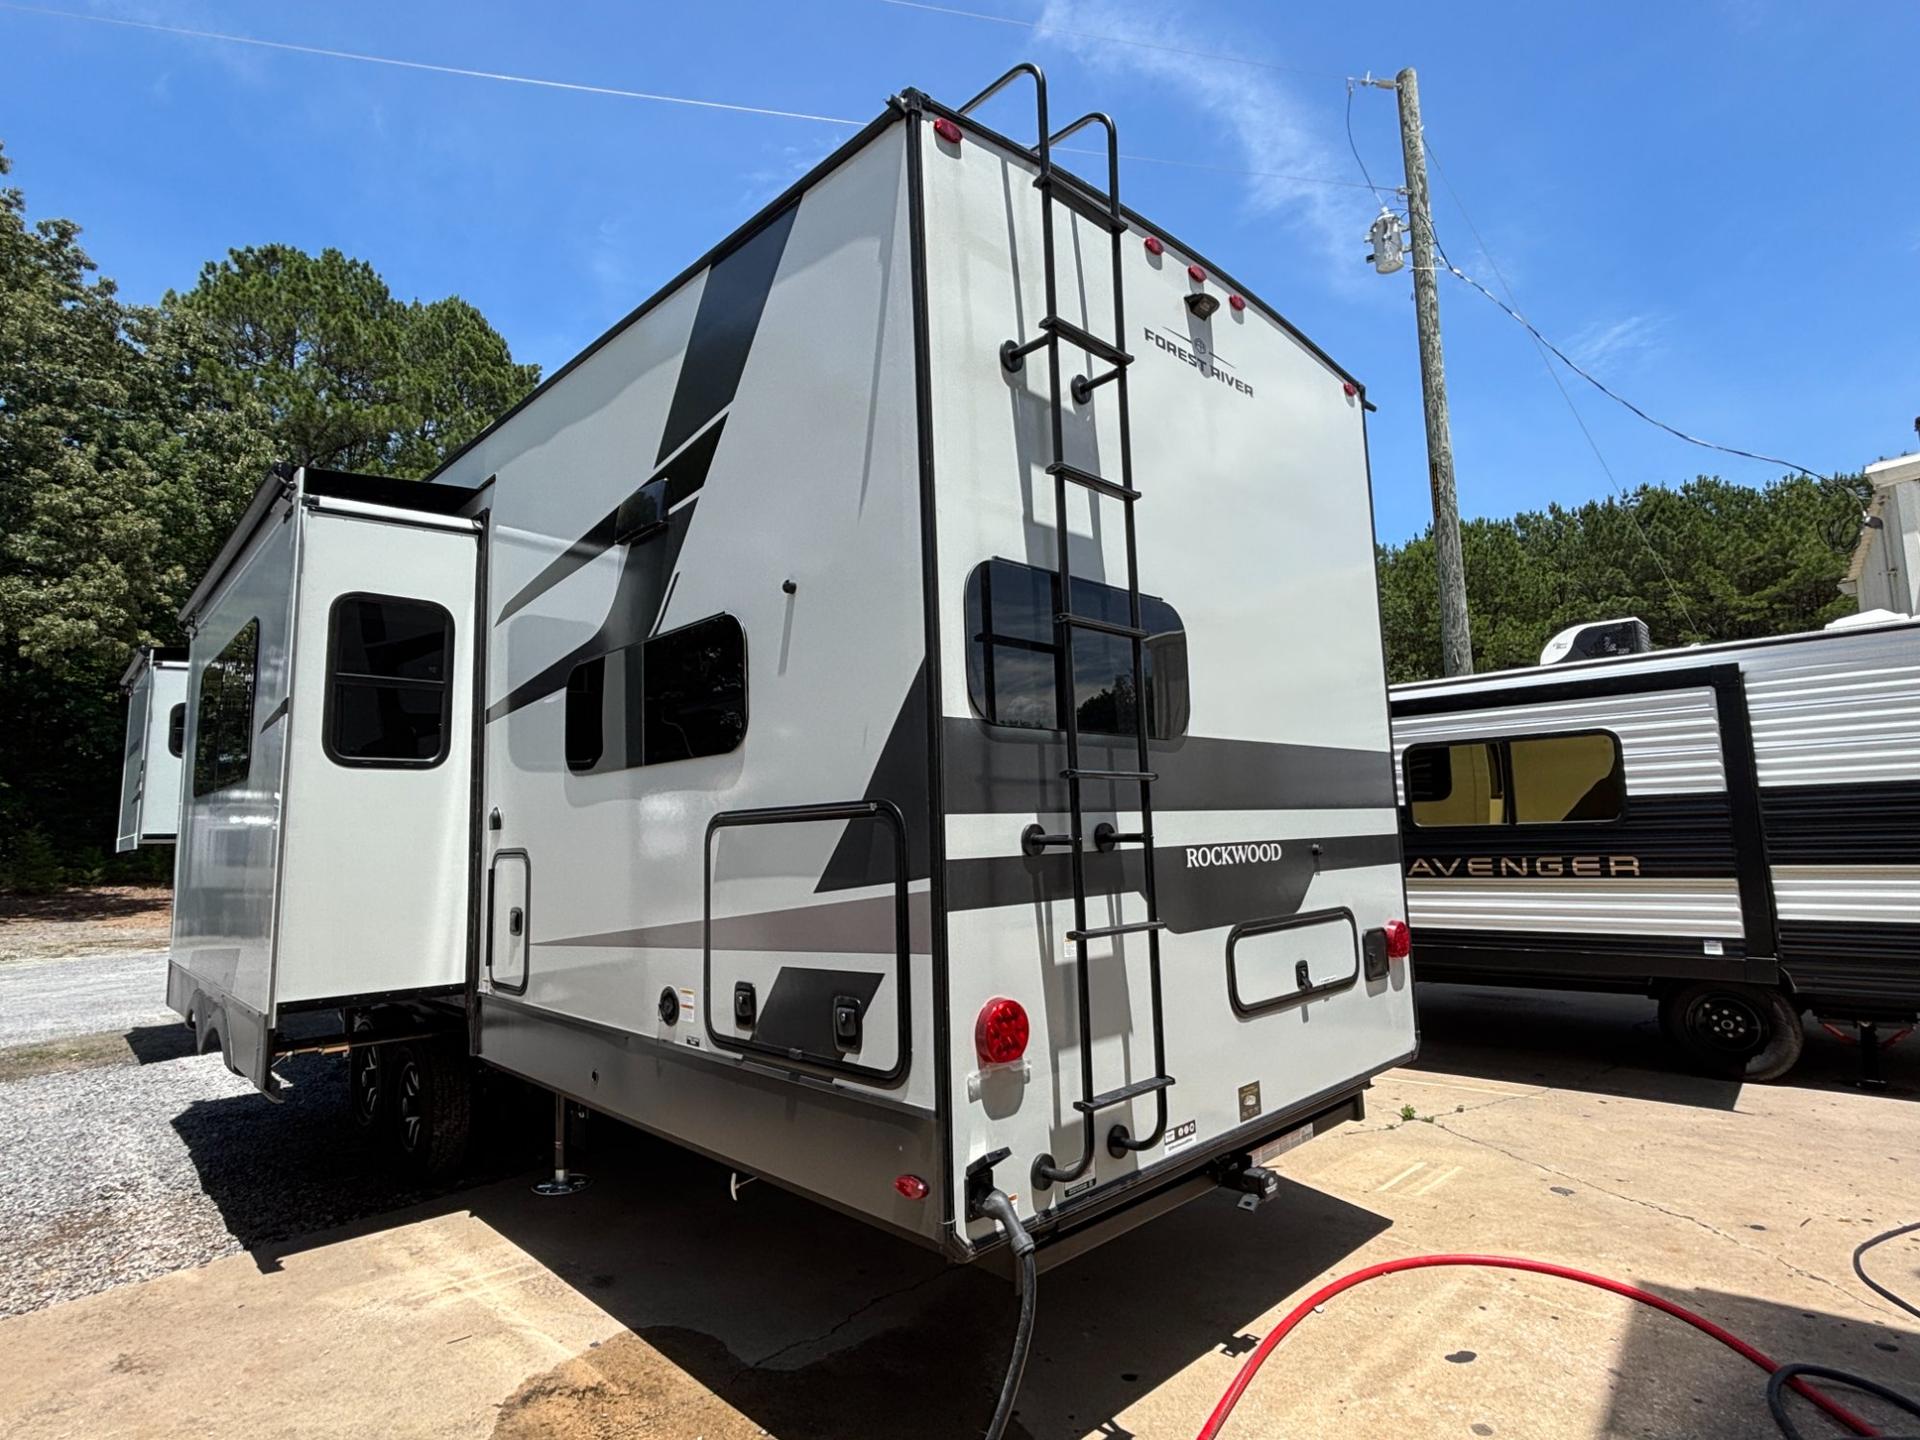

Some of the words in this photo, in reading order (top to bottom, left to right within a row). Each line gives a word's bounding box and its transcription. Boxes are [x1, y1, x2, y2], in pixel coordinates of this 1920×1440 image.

[1144, 327, 1206, 372] FOREST
[1210, 365, 1254, 398] RIVER
[1186, 843, 1282, 868] ROCKWOOD
[1408, 856, 1640, 876] AVENGER
